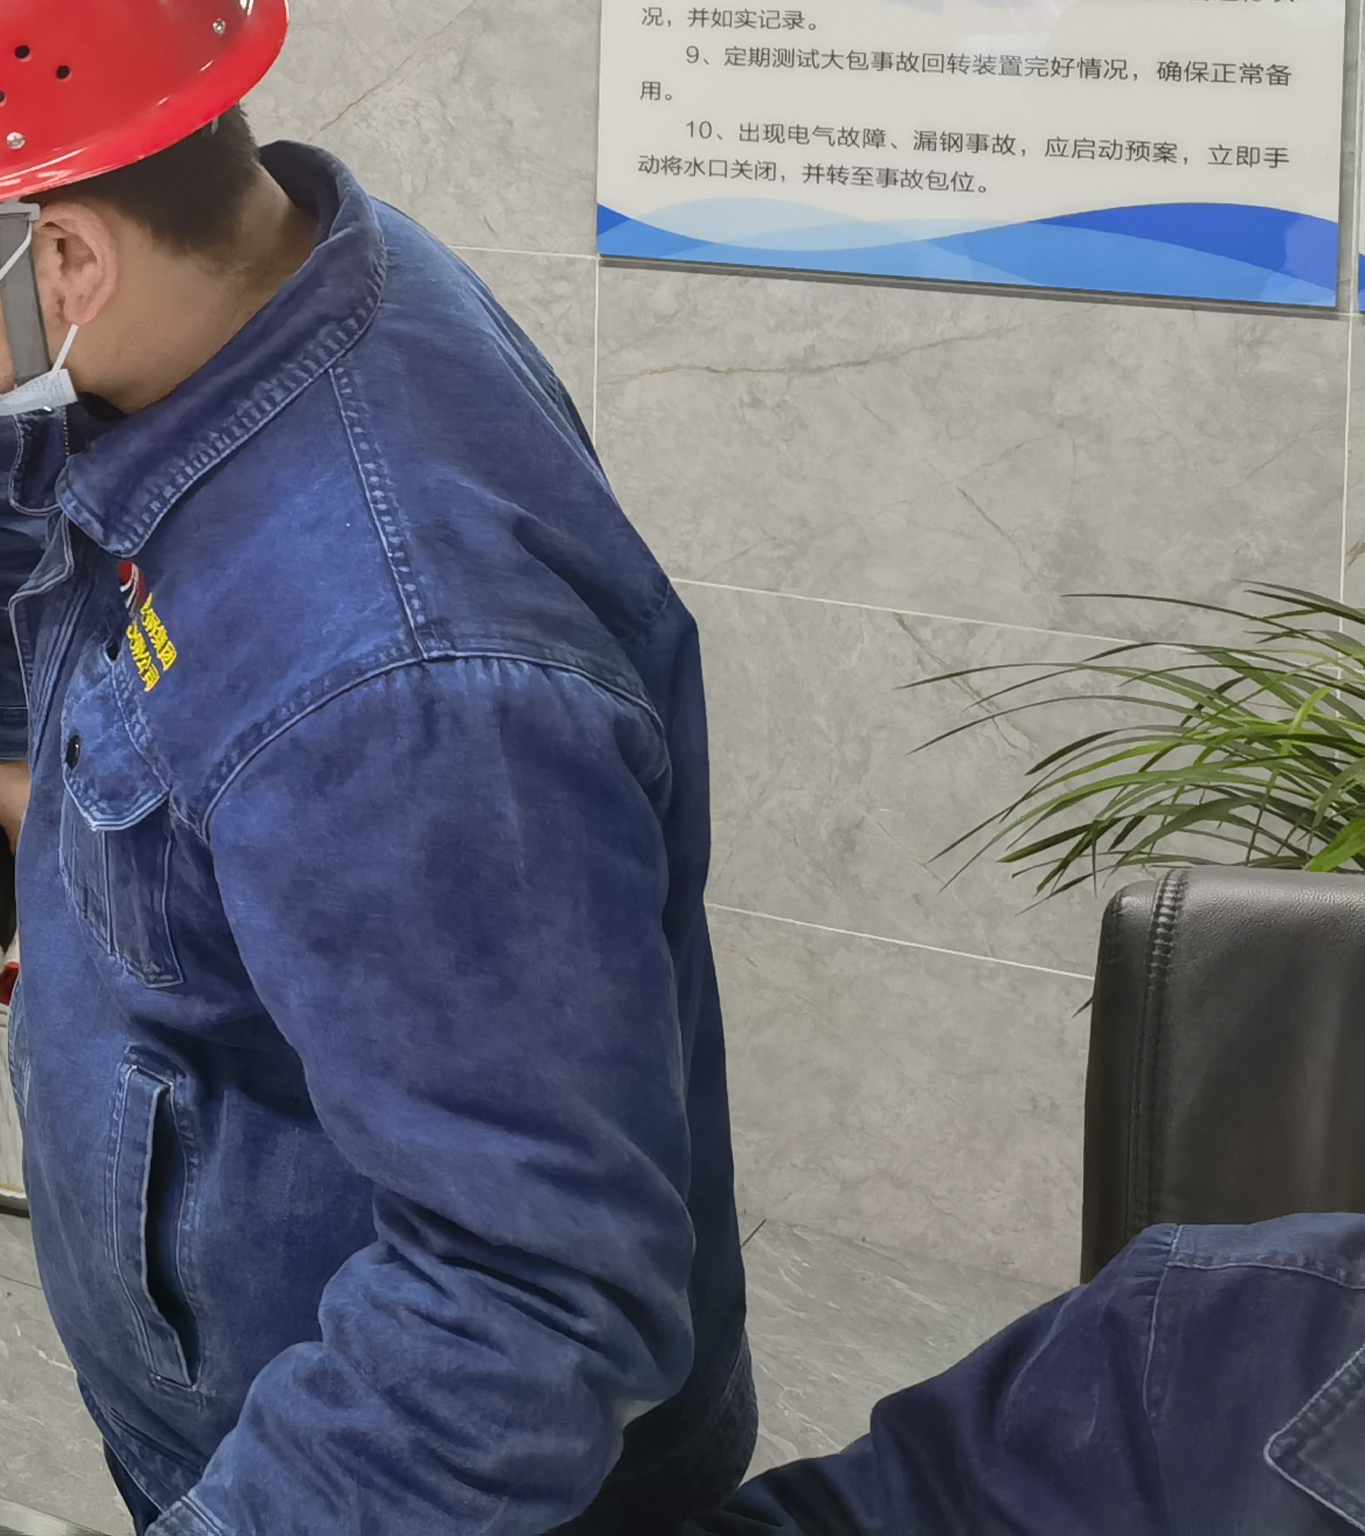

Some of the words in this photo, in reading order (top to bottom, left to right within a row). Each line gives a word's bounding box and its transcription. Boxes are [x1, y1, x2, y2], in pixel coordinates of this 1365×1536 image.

[641, 7, 820, 31] 况，并如实记录。
[685, 45, 1293, 88] 9、定期测试大包事故回转装置完好情况，确保正常备
[639, 81, 674, 103] 用。
[685, 120, 1290, 170] 10、出现电气故障、漏钢事故，应启动预案，立即手
[637, 154, 990, 195] 动将水口关闭，并转至事故包位。
